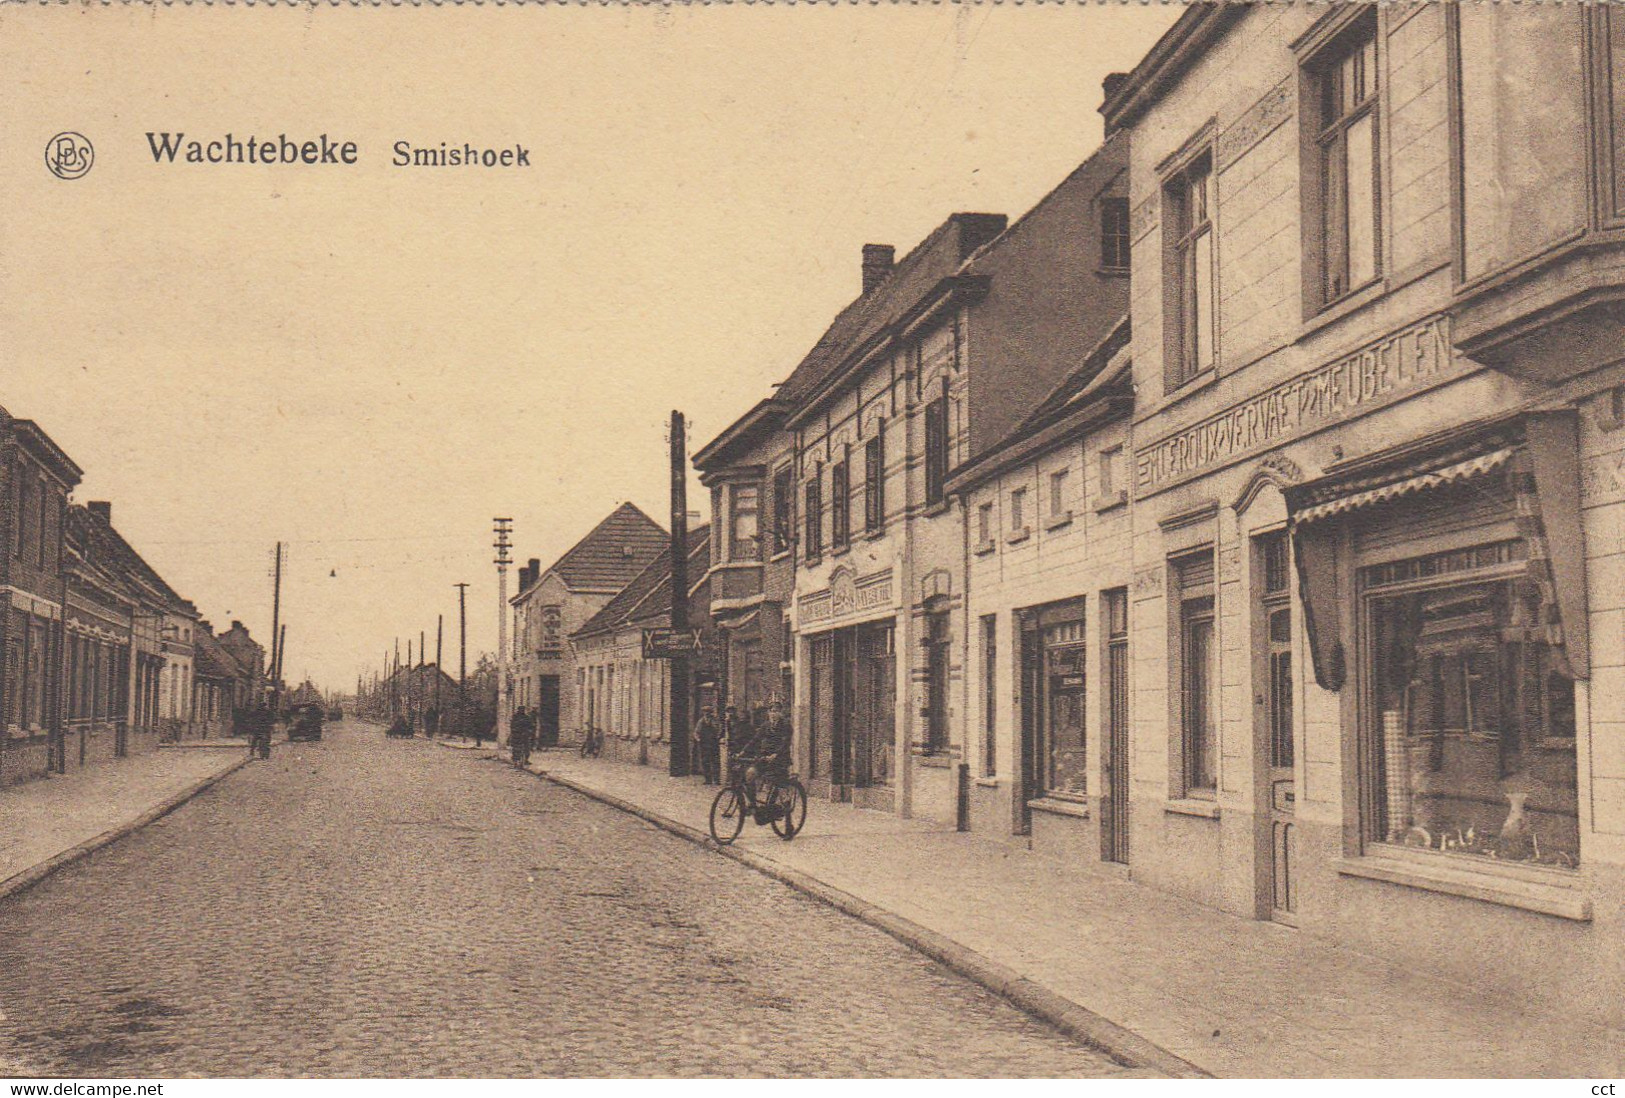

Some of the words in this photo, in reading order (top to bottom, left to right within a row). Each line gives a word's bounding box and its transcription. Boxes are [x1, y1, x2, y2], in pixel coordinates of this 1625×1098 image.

[146, 132, 358, 164] Wachtebeke
[393, 140, 531, 167] Smishoek
[1317, 314, 1453, 417] MEUBELEN
